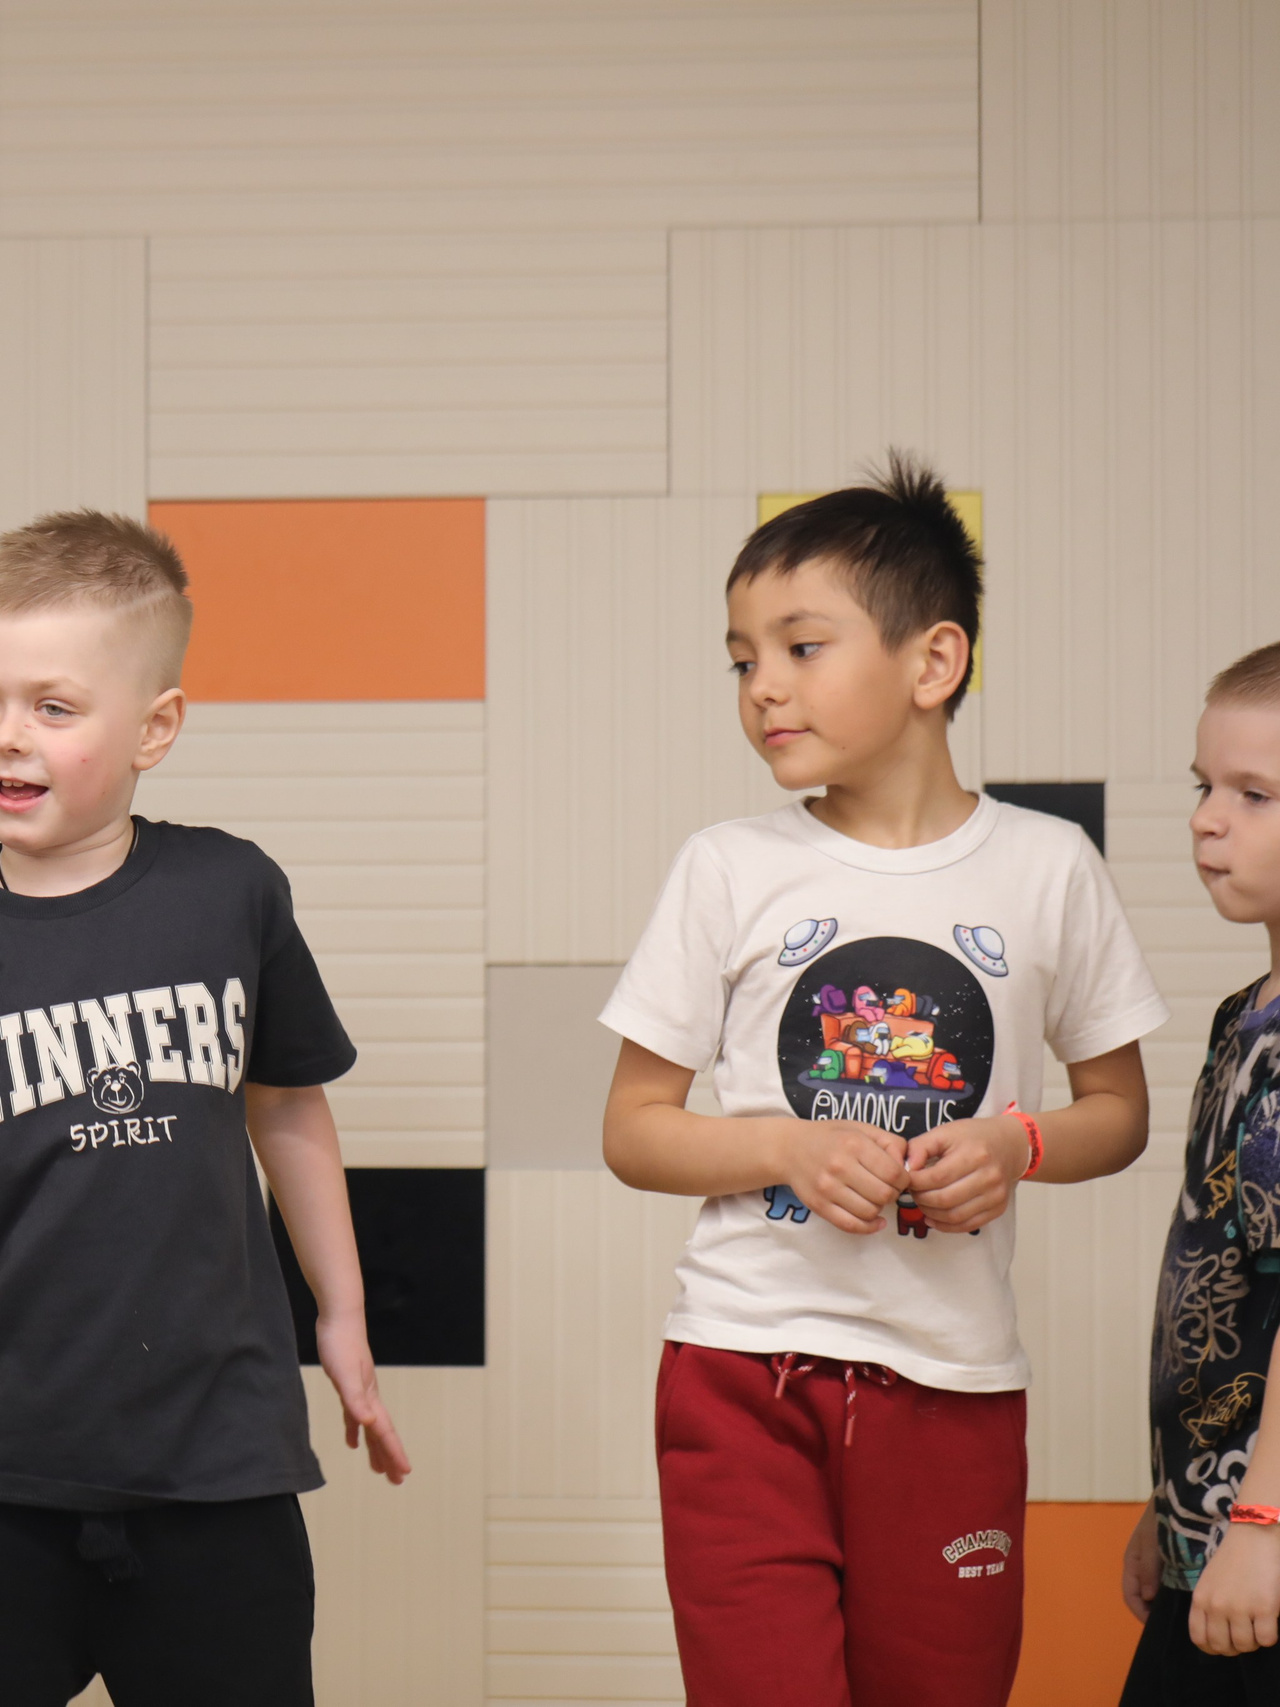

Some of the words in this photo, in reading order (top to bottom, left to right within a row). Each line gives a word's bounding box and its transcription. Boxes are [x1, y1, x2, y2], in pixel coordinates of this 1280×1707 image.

[811, 1088, 910, 1133] AMONG
[70, 1115, 178, 1151] SPIRIT
[959, 1566, 983, 1578] BEST
[986, 1561, 1005, 1575] TEAM
